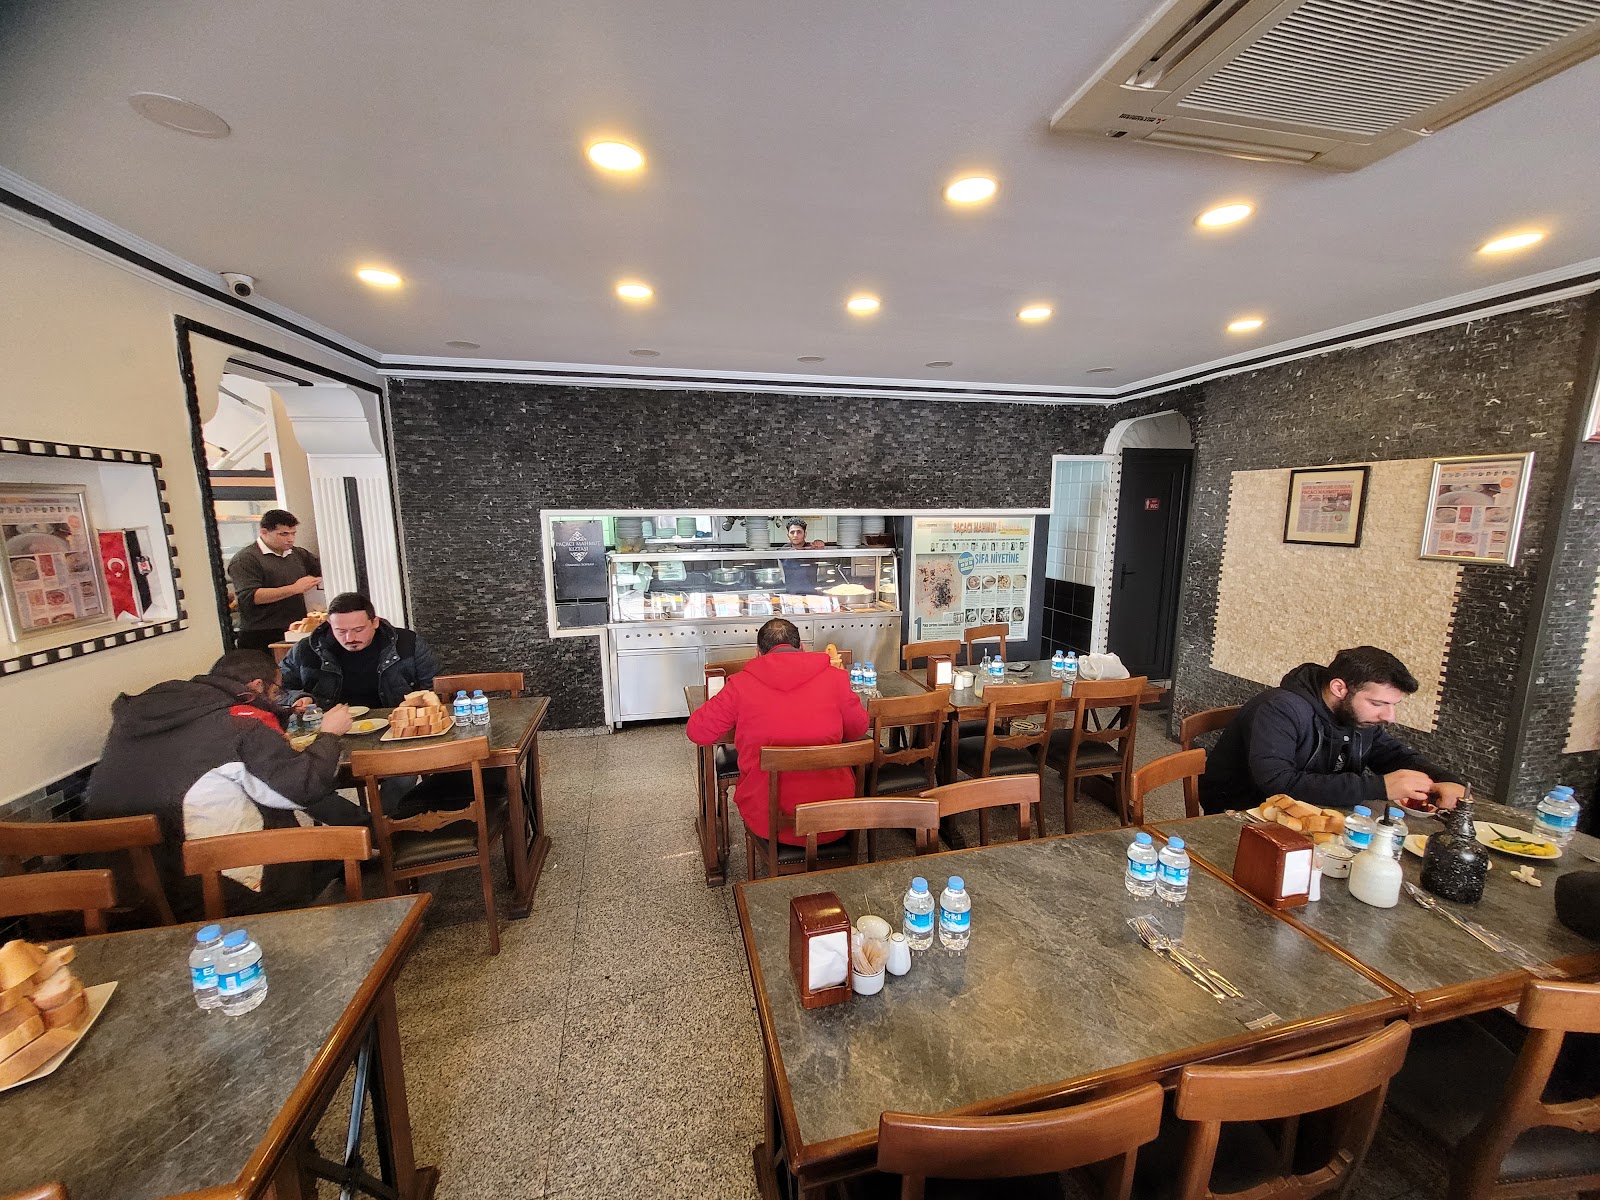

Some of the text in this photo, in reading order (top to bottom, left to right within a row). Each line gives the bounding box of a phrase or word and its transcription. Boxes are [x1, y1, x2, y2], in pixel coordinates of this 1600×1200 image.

[954, 522, 973, 535] PAÇACI
[990, 551, 1019, 564] NİYETİNE
[914, 616, 922, 640] 1
[943, 910, 962, 921] Erikli
